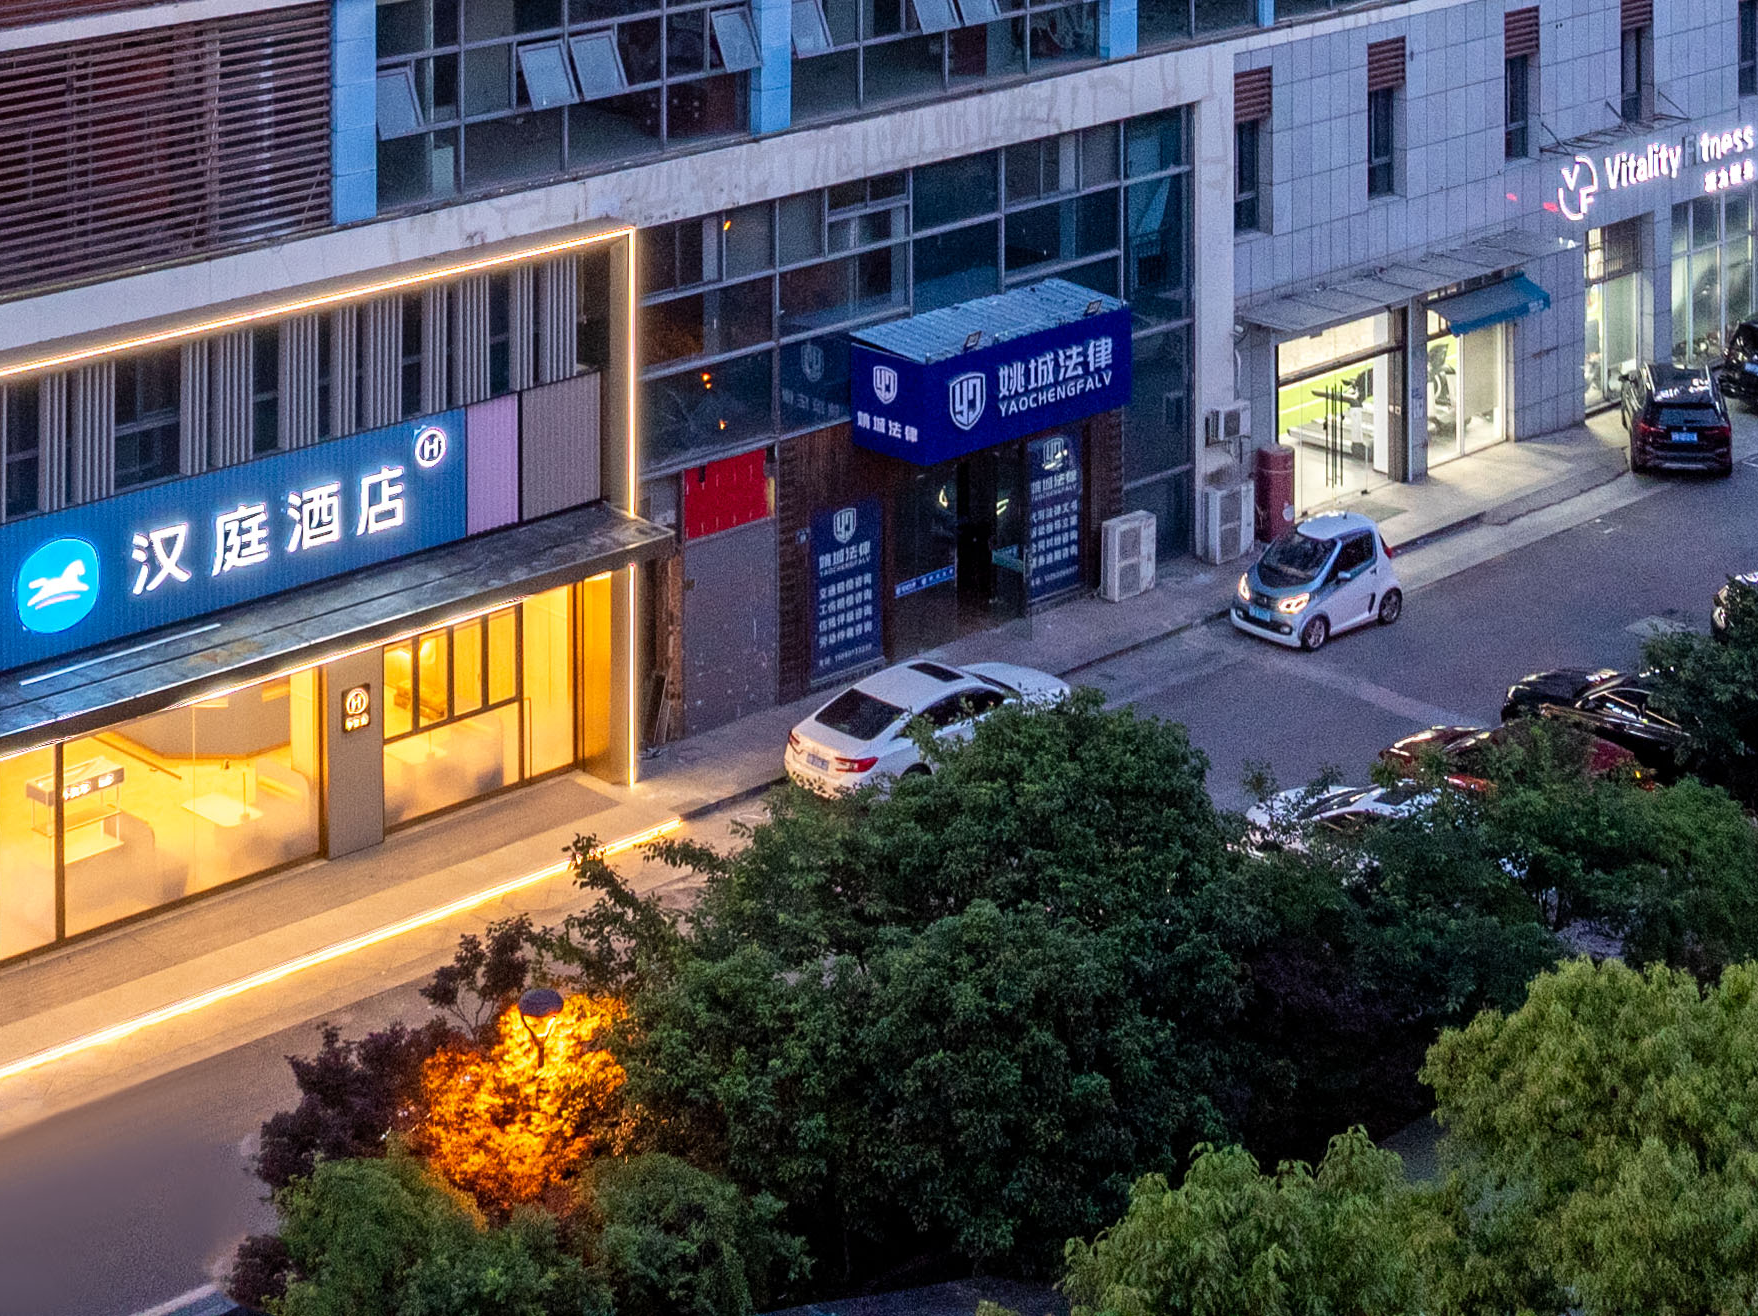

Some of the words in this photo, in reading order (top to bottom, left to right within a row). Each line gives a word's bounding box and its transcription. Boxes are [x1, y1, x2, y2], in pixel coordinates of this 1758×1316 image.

[1604, 142, 1682, 190] Vitality
[1681, 124, 1755, 169] Fitness
[997, 336, 1113, 399] 姚城法律
[998, 369, 1113, 418] YAOCHENGFALV
[857, 410, 919, 444] 姚城法律
[131, 464, 409, 596] 汉庭酒店
